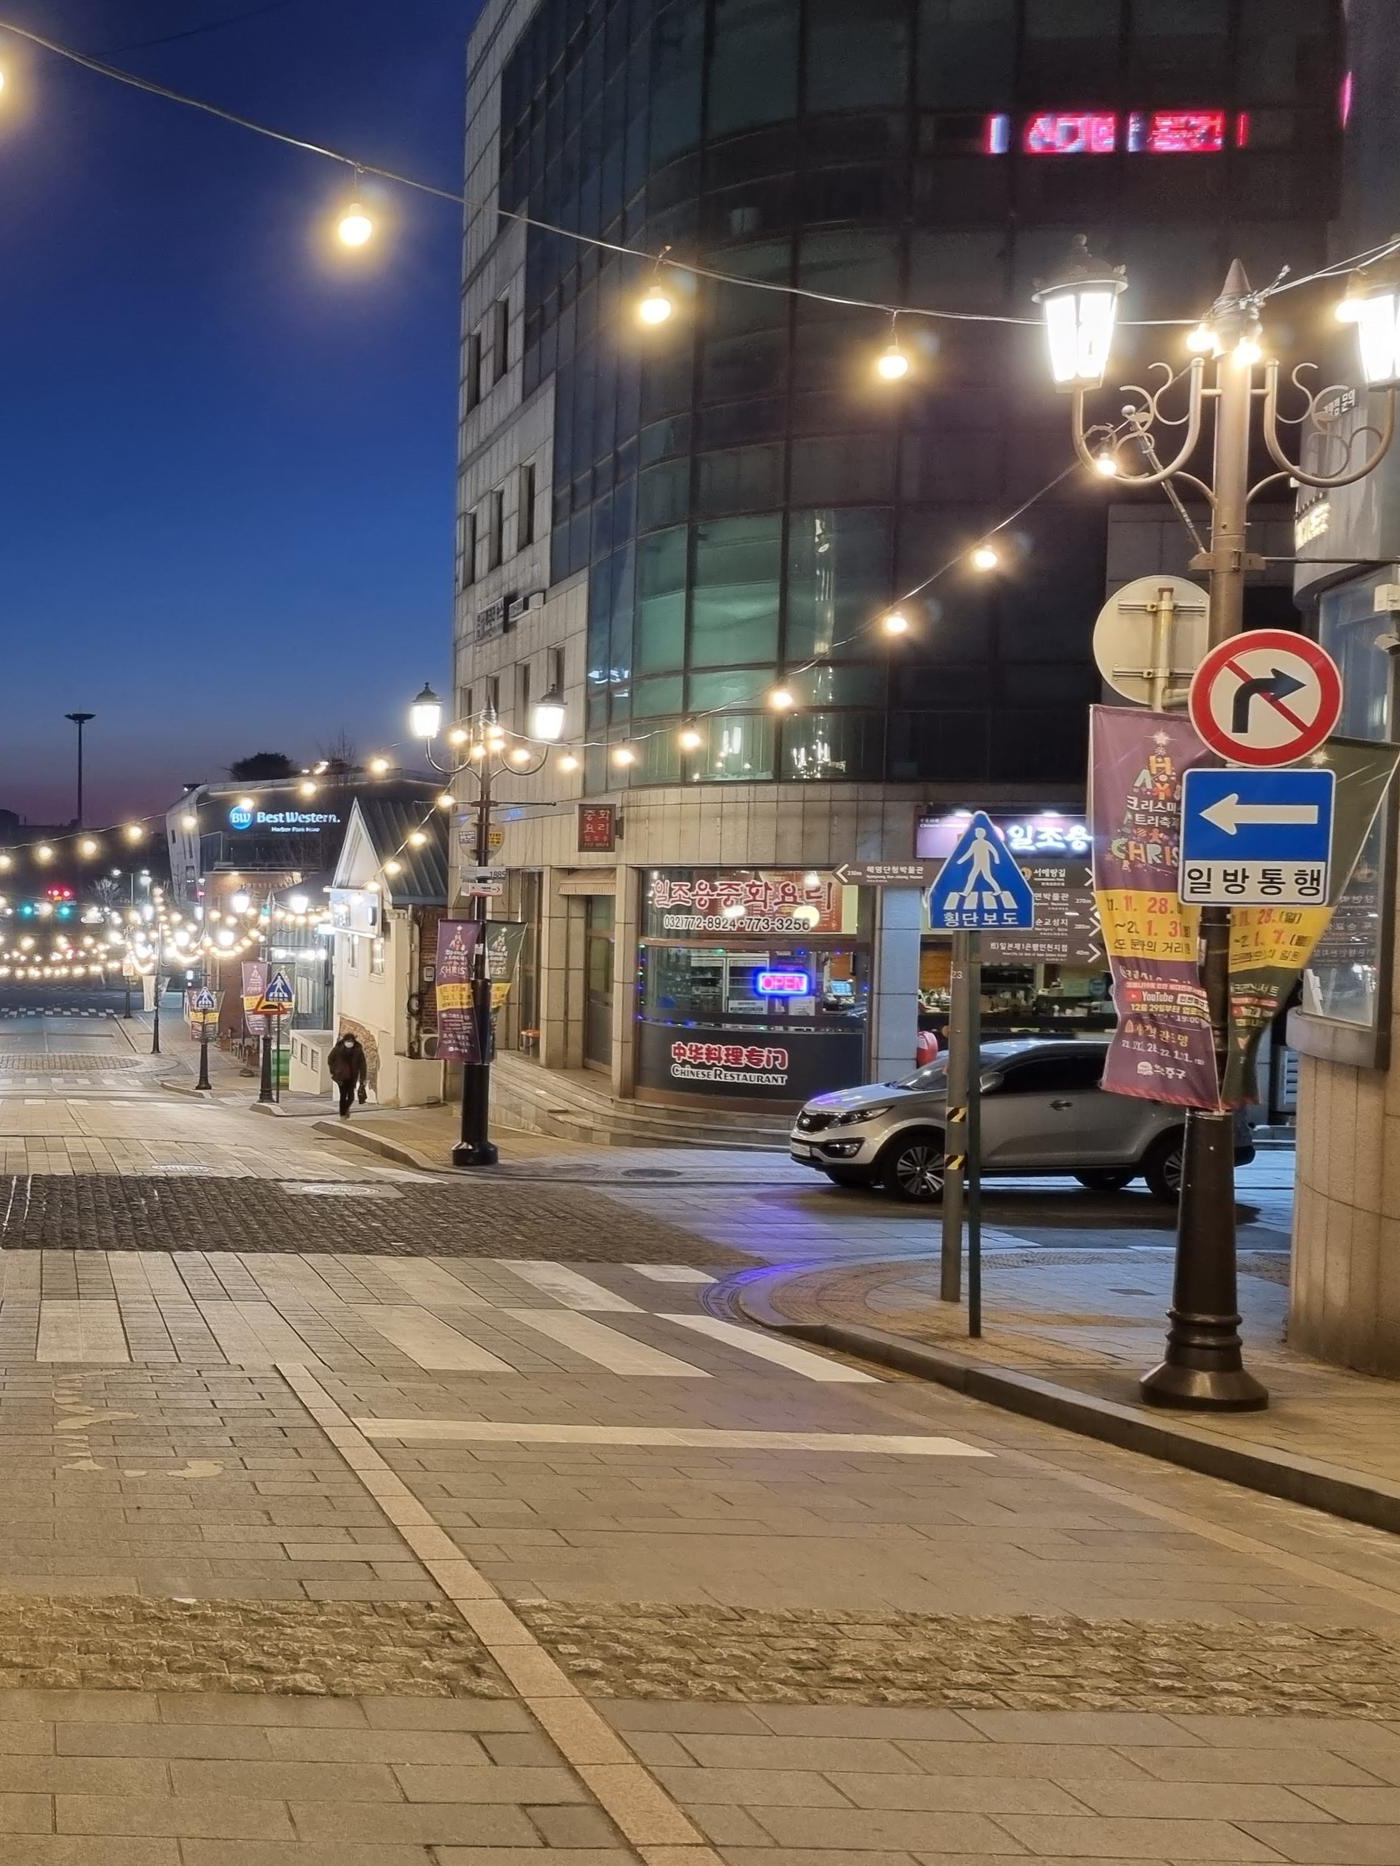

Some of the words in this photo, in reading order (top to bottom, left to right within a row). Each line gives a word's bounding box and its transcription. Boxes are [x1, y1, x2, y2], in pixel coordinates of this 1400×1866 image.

[256, 811, 285, 823] Best
[1006, 824, 1094, 851] 일조용
[1187, 866, 1321, 897] 일방통행
[943, 911, 1019, 928] 횡단보도
[761, 975, 806, 991] OPEN
[1142, 990, 1174, 1003] YouTube
[671, 1040, 789, 1070] 中华料理专门
[712, 1067, 789, 1085] RESTAURANT
